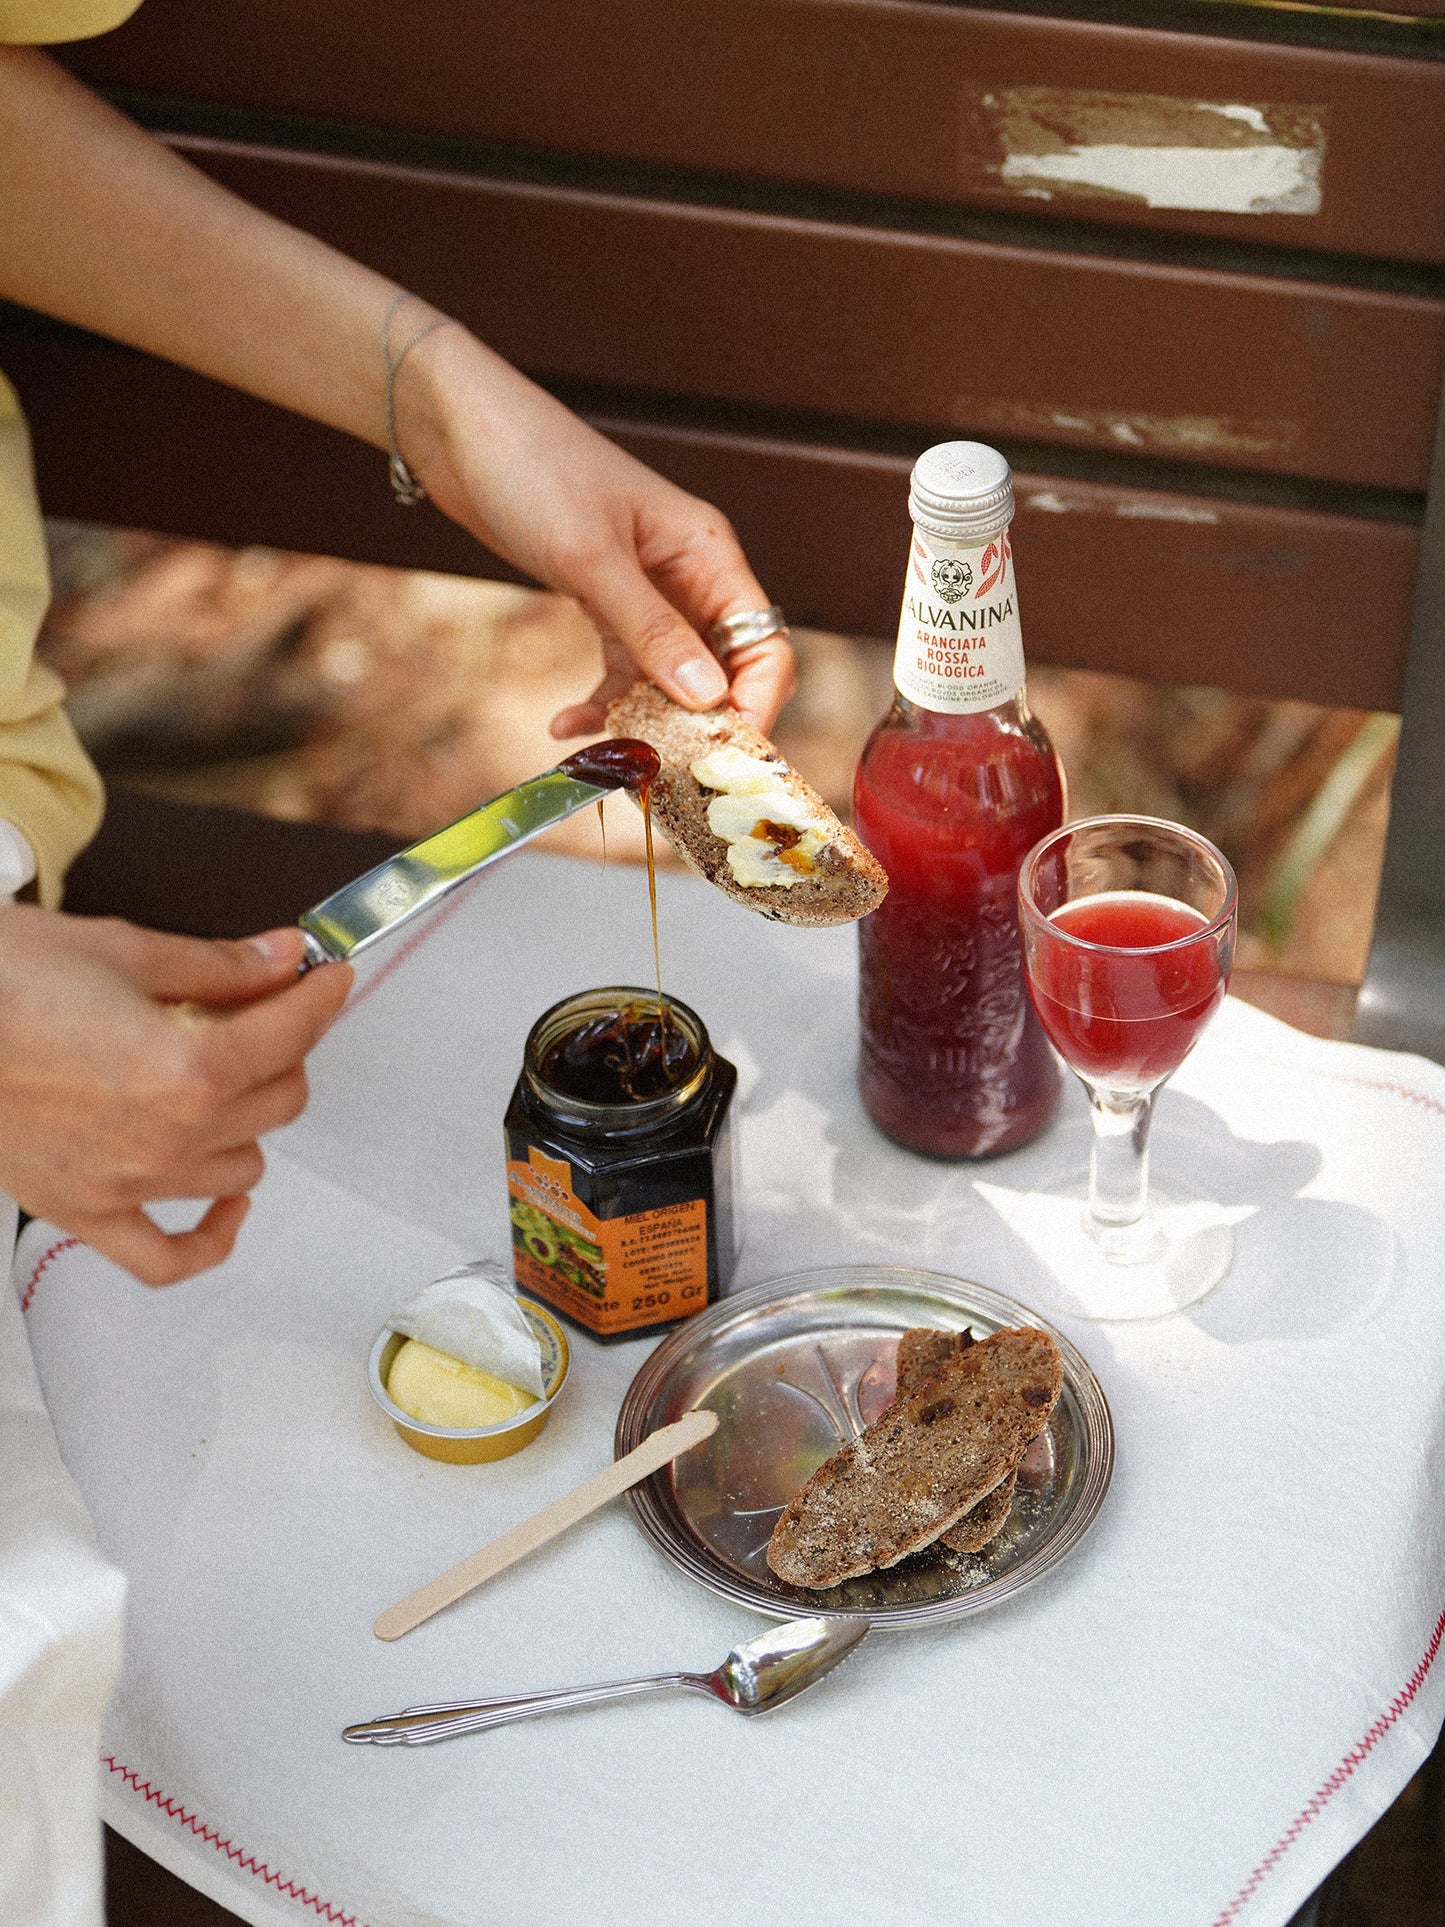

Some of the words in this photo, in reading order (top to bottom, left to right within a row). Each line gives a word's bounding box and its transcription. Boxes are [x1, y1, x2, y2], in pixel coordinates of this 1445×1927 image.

[907, 596, 1013, 631] ALVANINA
[917, 630, 987, 650] ARANCIATA
[927, 648, 969, 664] ROSSA
[917, 657, 985, 678] BIOLOGICA
[967, 679, 998, 690] ORANGE
[624, 1212, 649, 1225] MIEL
[632, 1291, 671, 1312] 250
[681, 1285, 703, 1300] Gr
